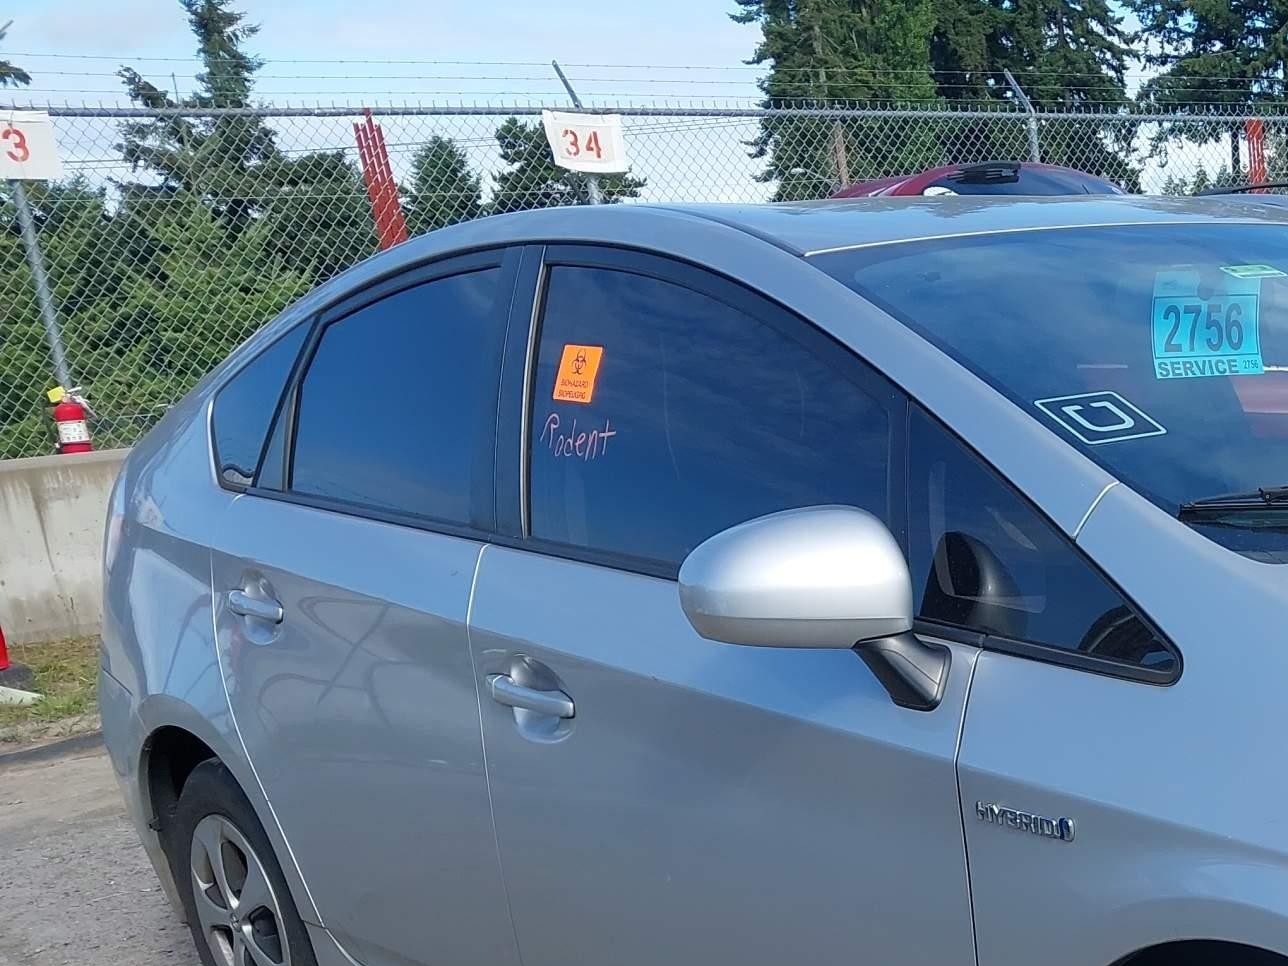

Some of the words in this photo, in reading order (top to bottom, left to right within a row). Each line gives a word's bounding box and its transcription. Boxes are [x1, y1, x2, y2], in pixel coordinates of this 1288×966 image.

[562, 129, 602, 159] 34
[1163, 303, 1244, 353] 2756
[1157, 359, 1240, 378] SERVICE
[1242, 359, 1260, 369] 2756
[539, 413, 617, 461] Rodent
[976, 801, 1059, 838] HYBRID
